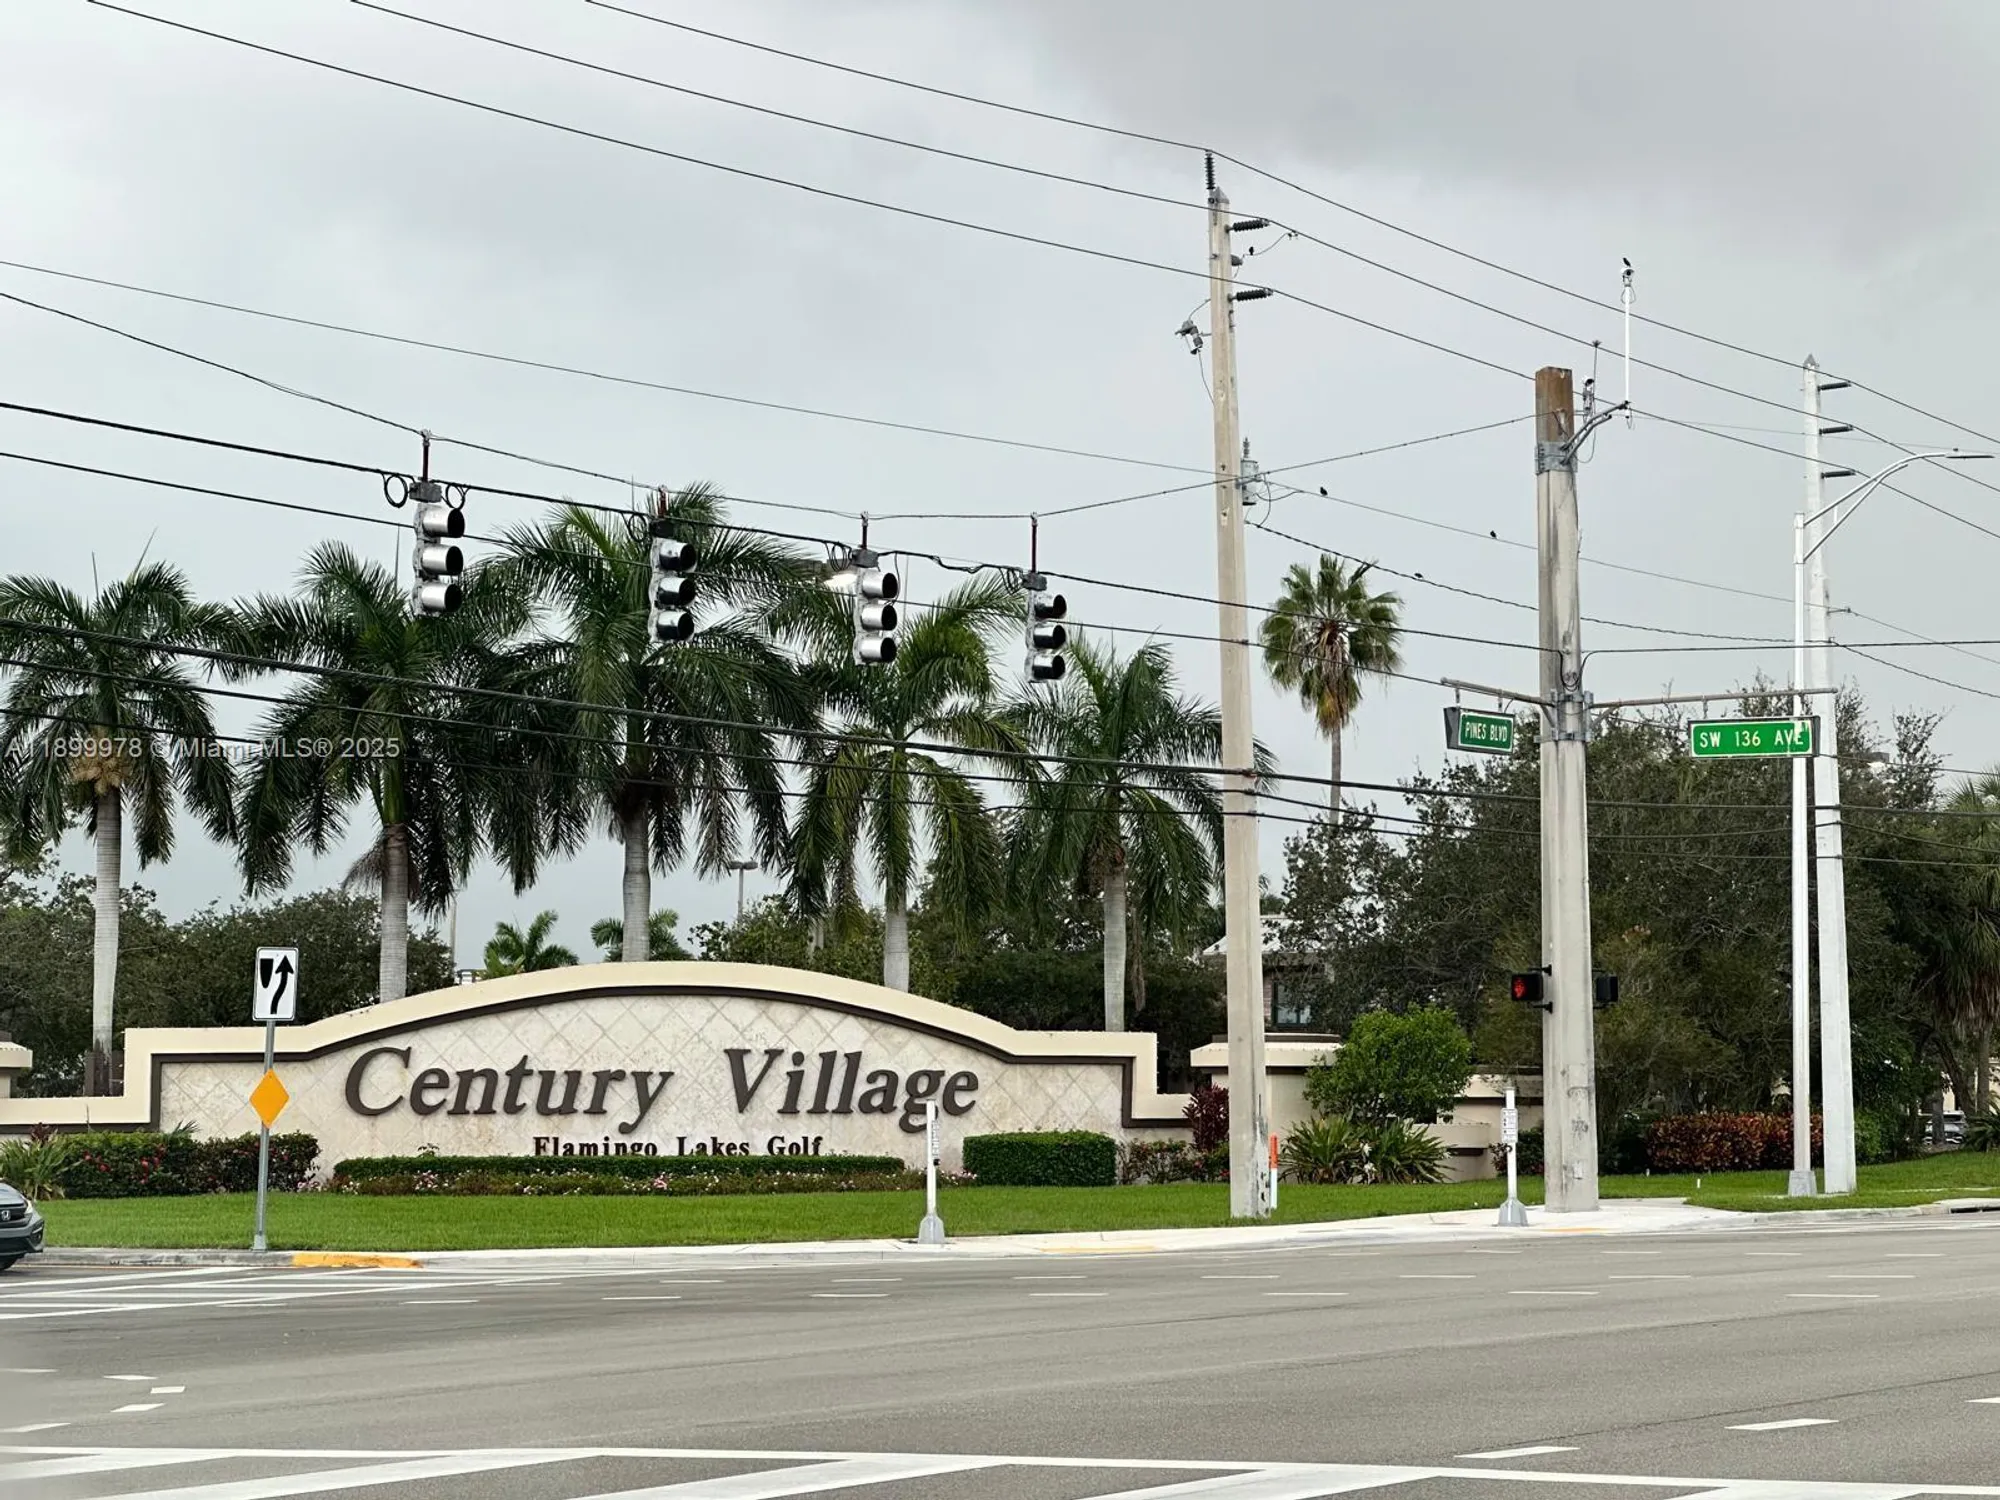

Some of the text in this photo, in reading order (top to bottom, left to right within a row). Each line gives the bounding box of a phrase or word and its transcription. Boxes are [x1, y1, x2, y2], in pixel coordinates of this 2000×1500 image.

[1465, 721, 1508, 742] PINES BLVD
[1700, 729, 1804, 748] SW 136 AVE
[345, 1045, 979, 1134] Century Village
[532, 1135, 823, 1156] Flamingo Lakes Golf
